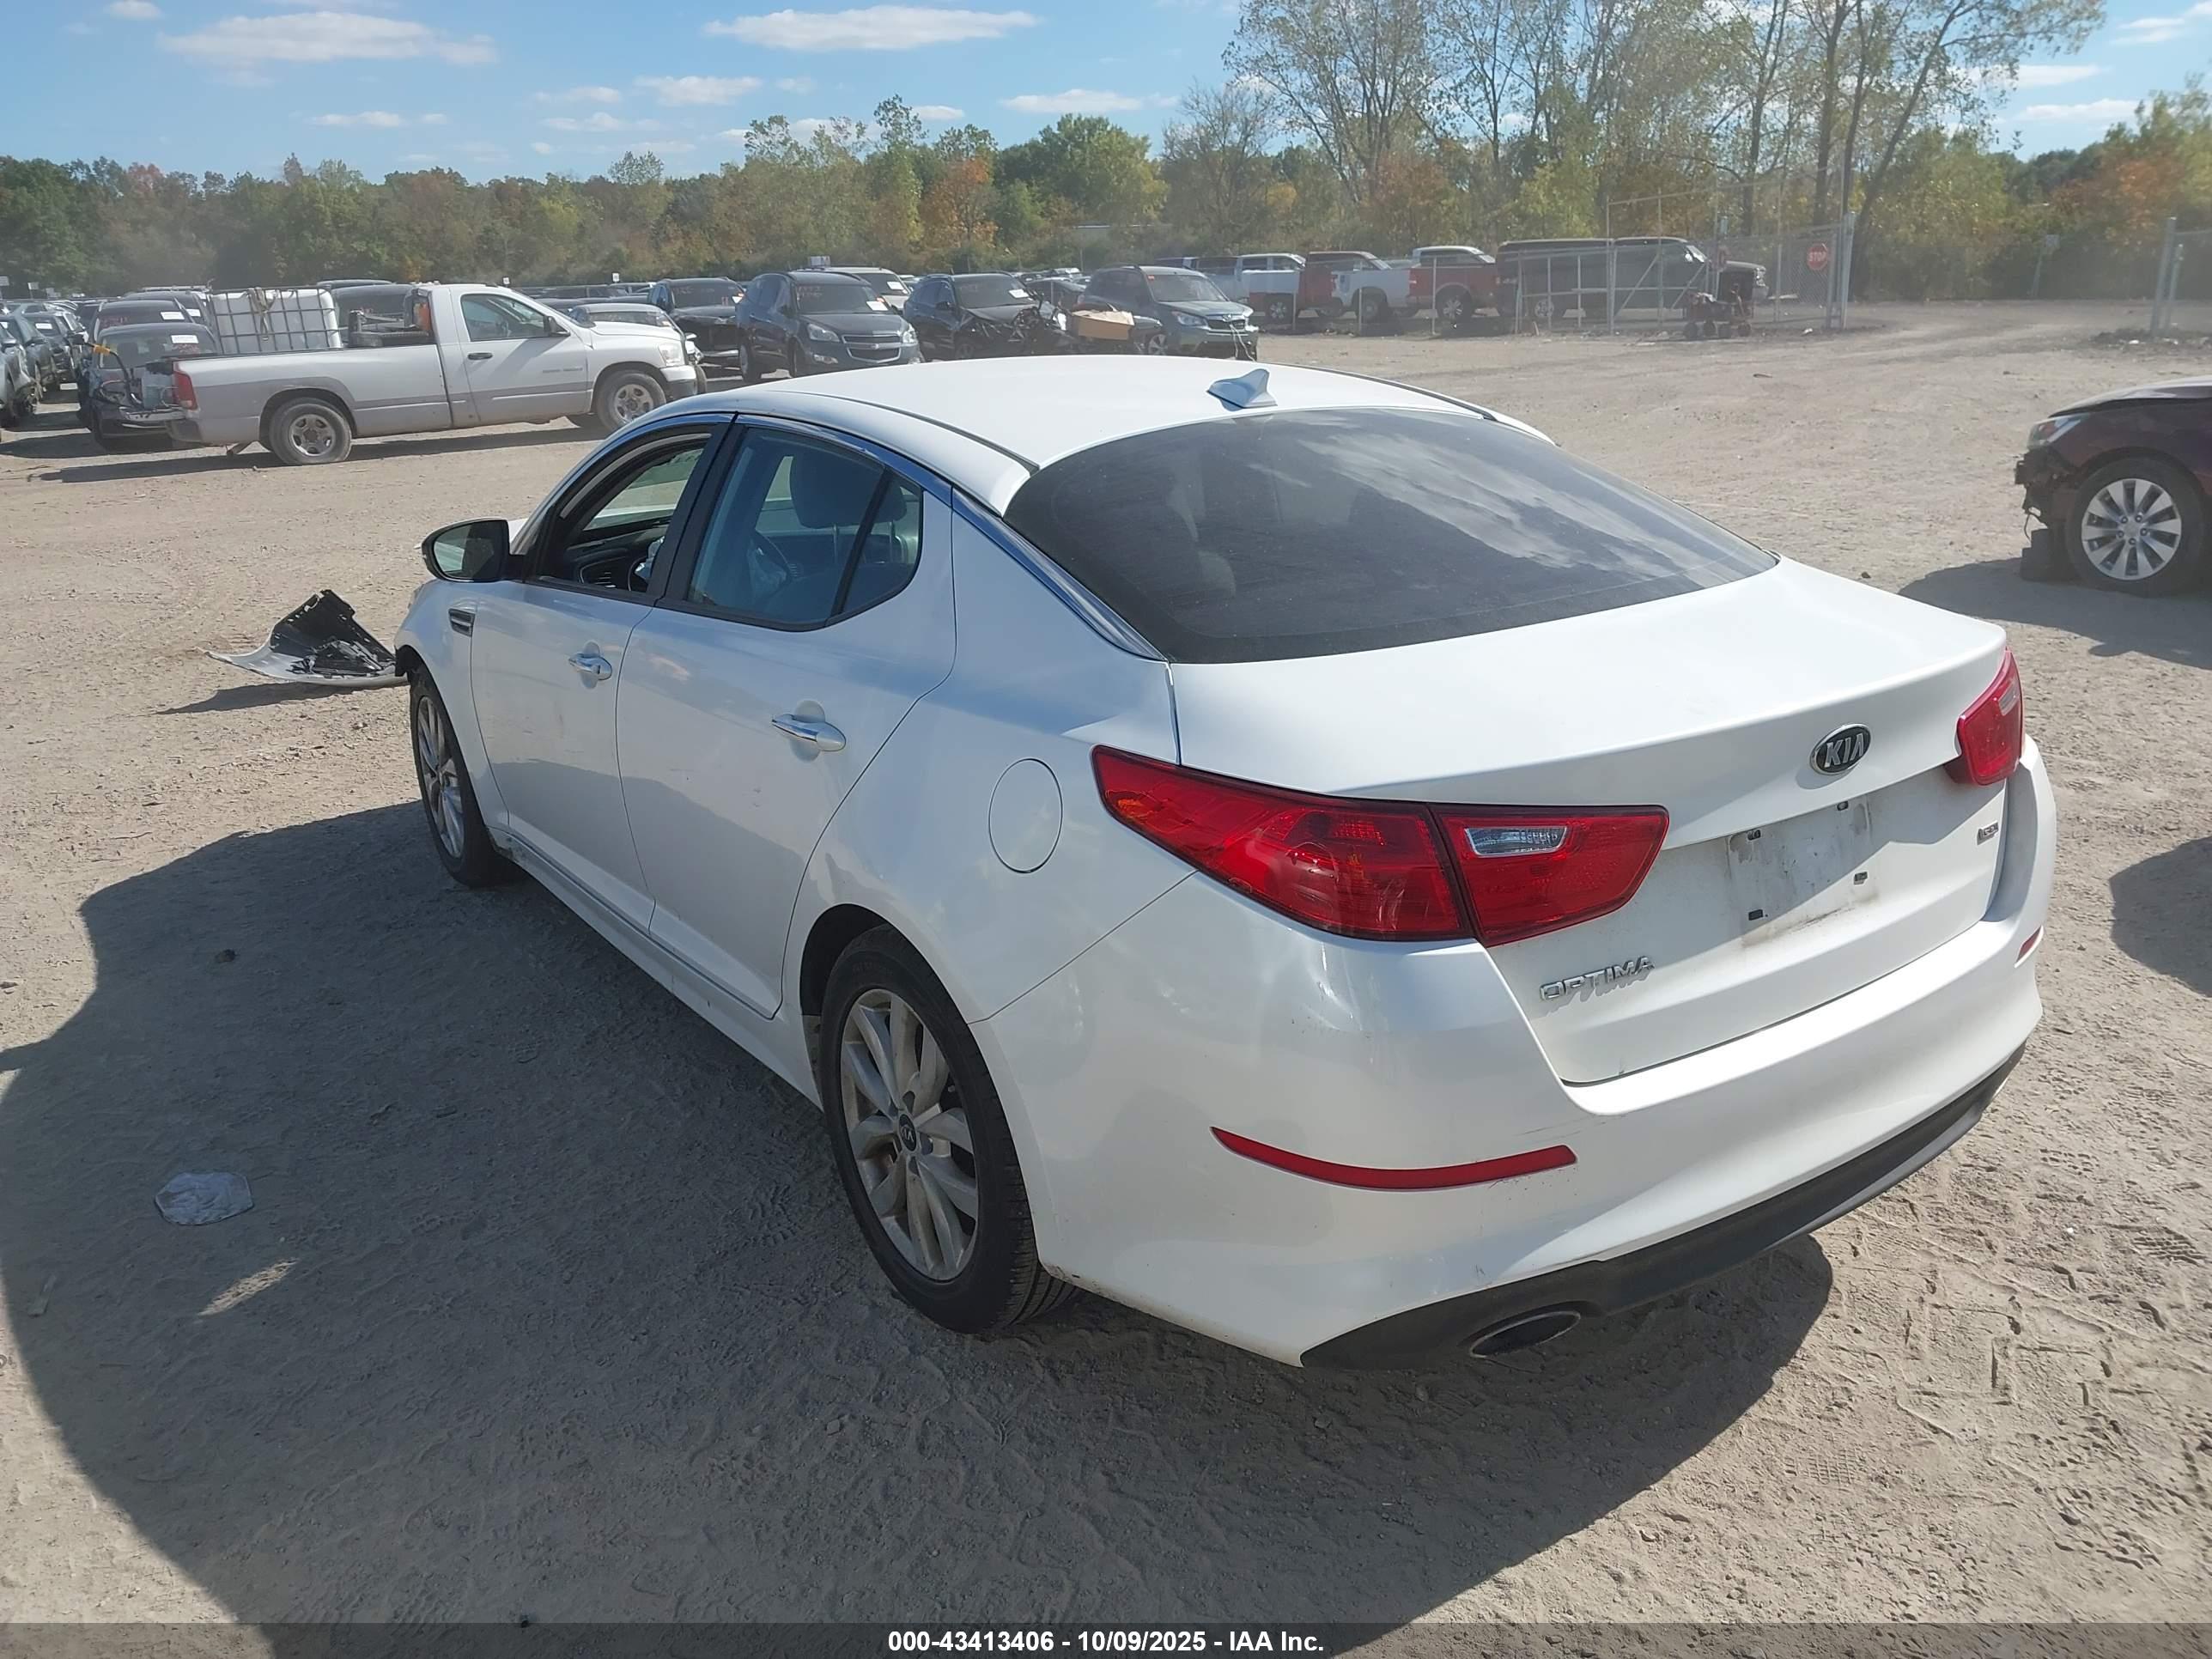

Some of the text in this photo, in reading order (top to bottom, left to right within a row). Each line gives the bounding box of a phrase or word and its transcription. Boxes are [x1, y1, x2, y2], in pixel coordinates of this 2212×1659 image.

[1808, 251, 1828, 262] STOP
[1824, 733, 1864, 768] KIA
[1540, 956, 1655, 1001] OPTIMA
